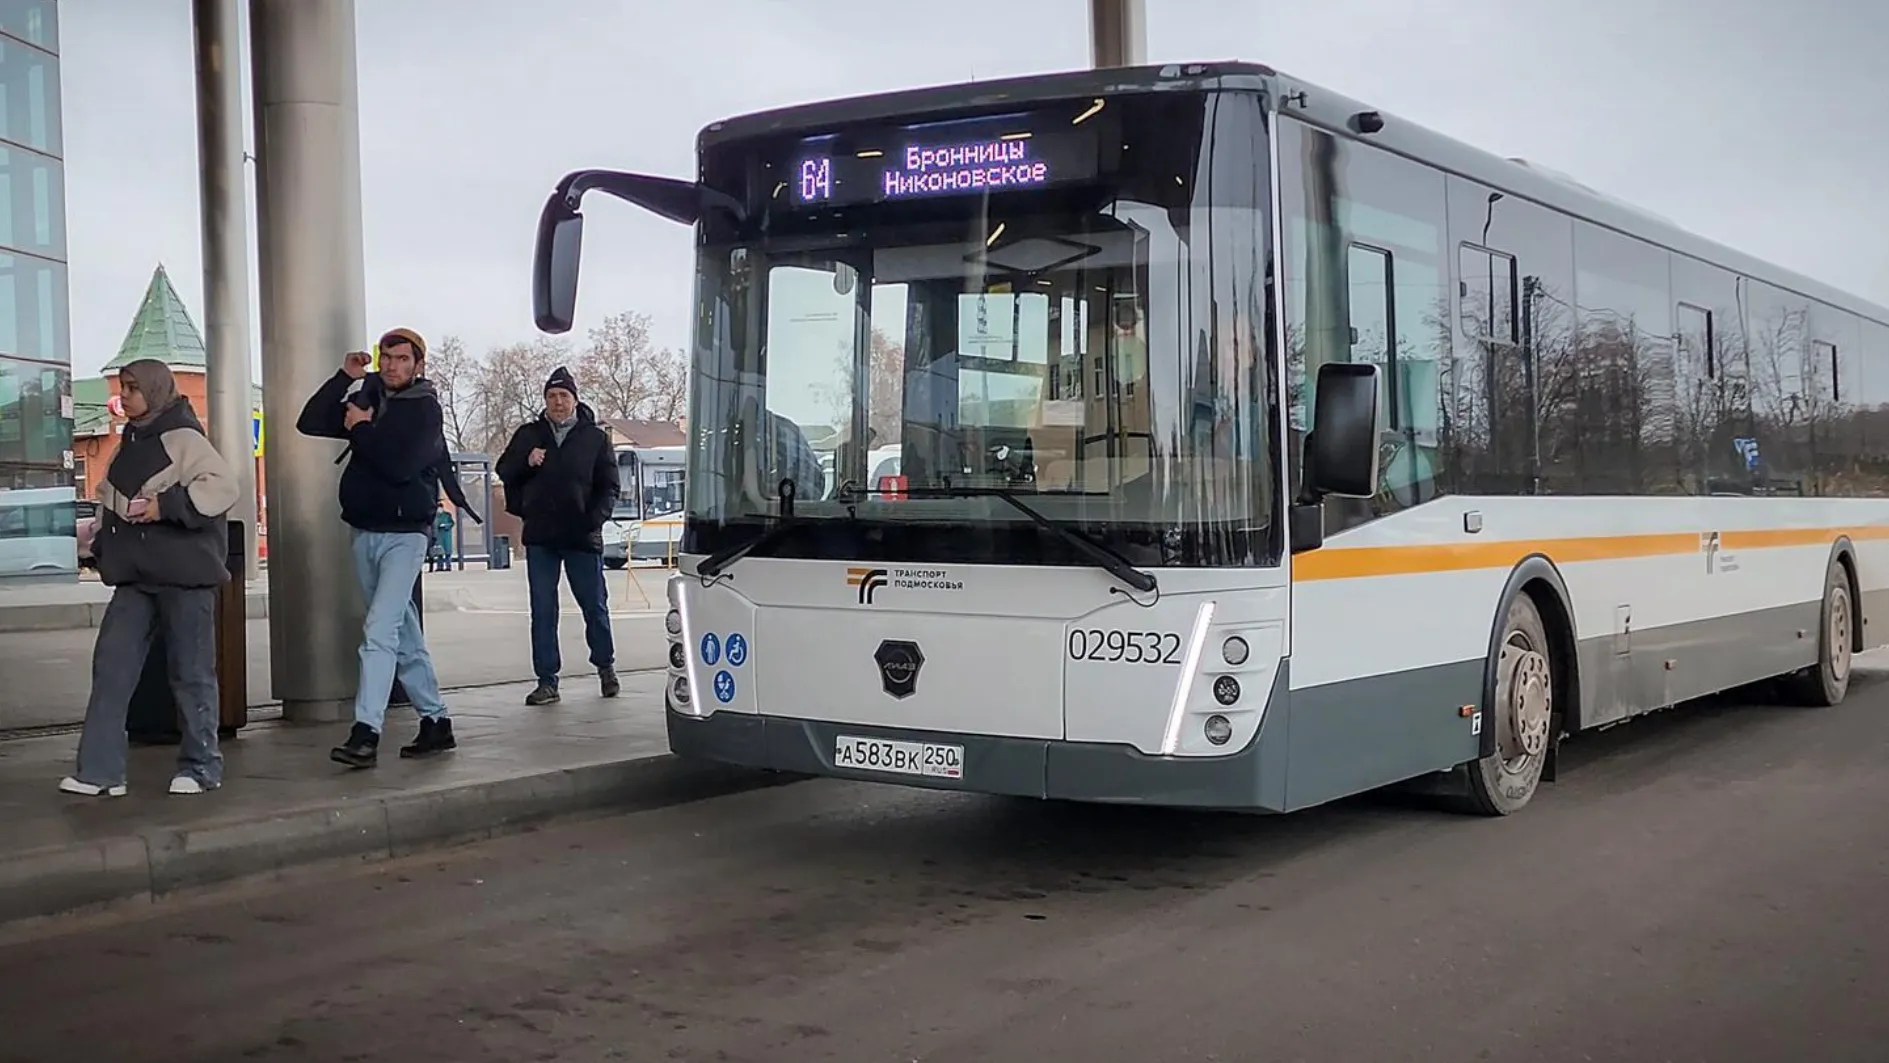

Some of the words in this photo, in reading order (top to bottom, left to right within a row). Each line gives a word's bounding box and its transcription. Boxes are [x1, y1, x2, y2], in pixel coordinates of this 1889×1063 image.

[907, 140, 1024, 171] Бронницы
[802, 158, 830, 199] 64
[885, 163, 1047, 195] Никоновское
[894, 569, 947, 578] ТРАНСПОРТ
[894, 580, 963, 589] ПОДМОСКОВЬЯ
[1069, 629, 1181, 664] 029532
[924, 747, 956, 766] 250
